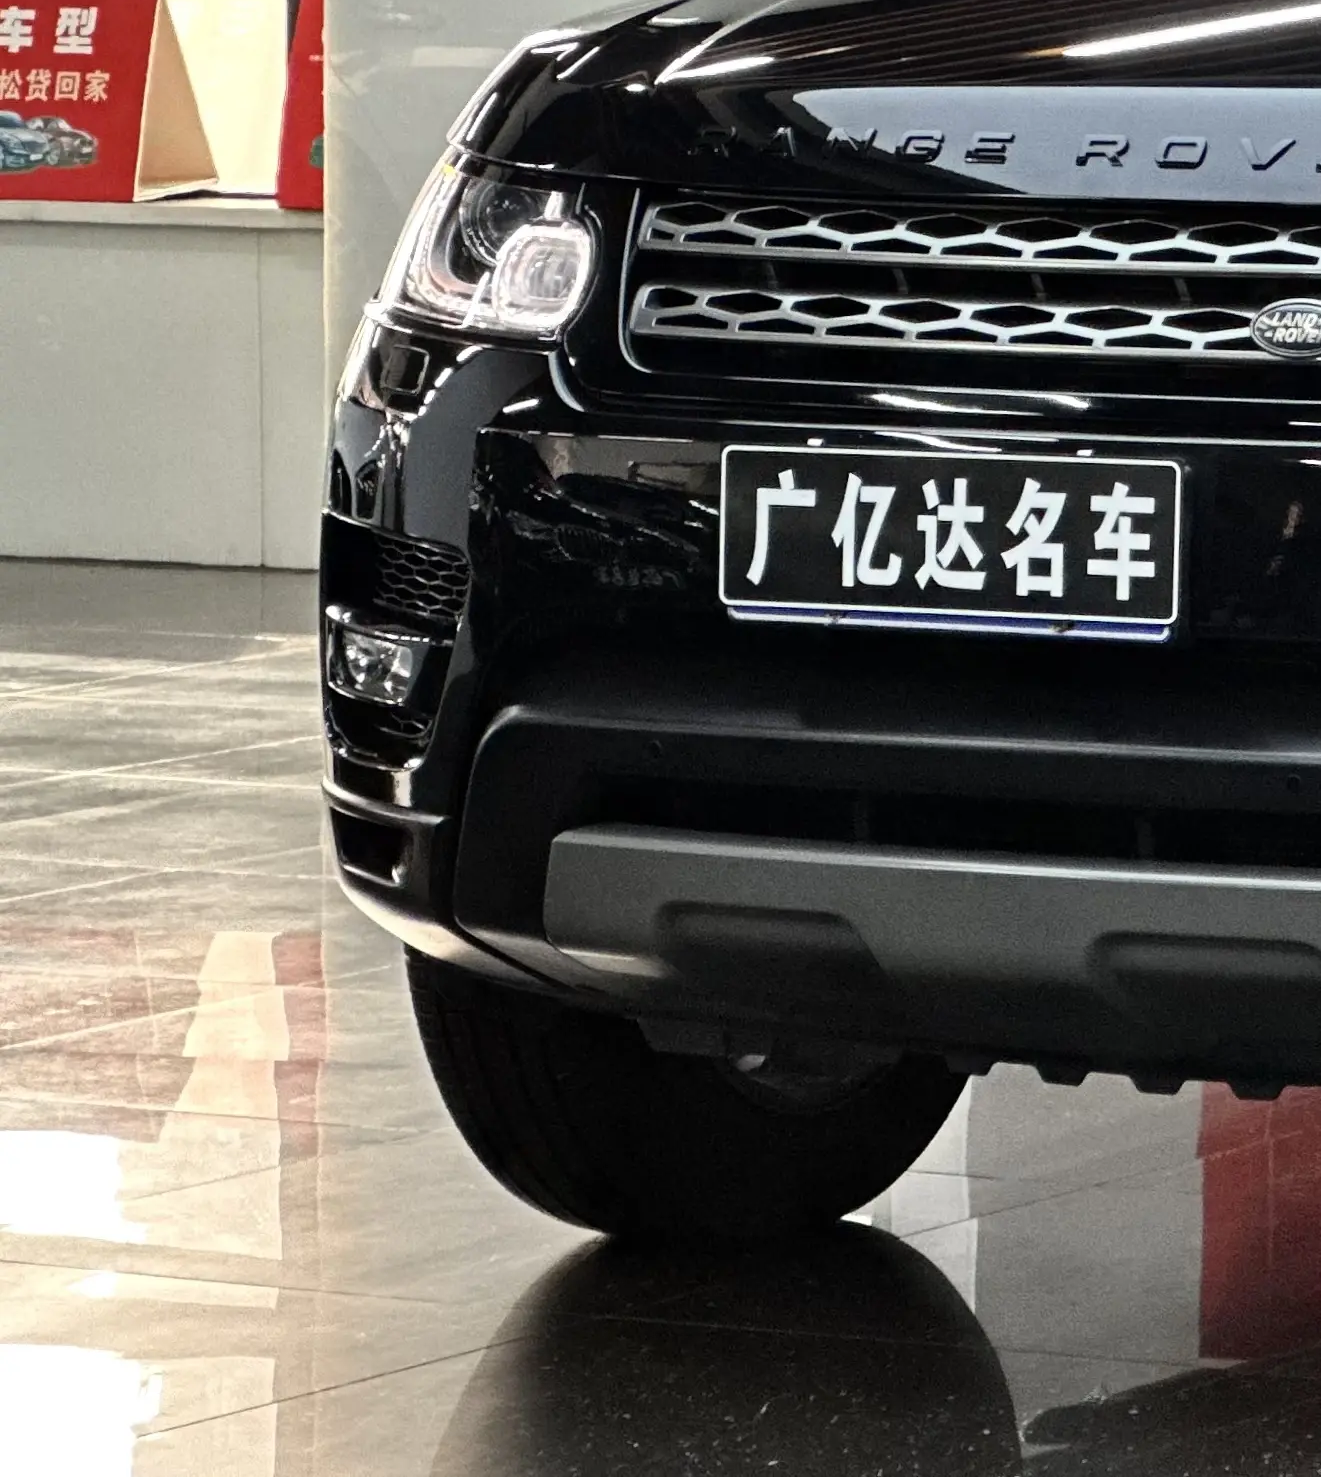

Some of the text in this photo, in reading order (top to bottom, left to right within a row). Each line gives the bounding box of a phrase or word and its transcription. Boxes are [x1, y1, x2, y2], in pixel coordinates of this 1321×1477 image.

[0, 5, 98, 54] 车型
[1270, 311, 1319, 328] LAND
[745, 468, 1156, 602] 广亿达名车
